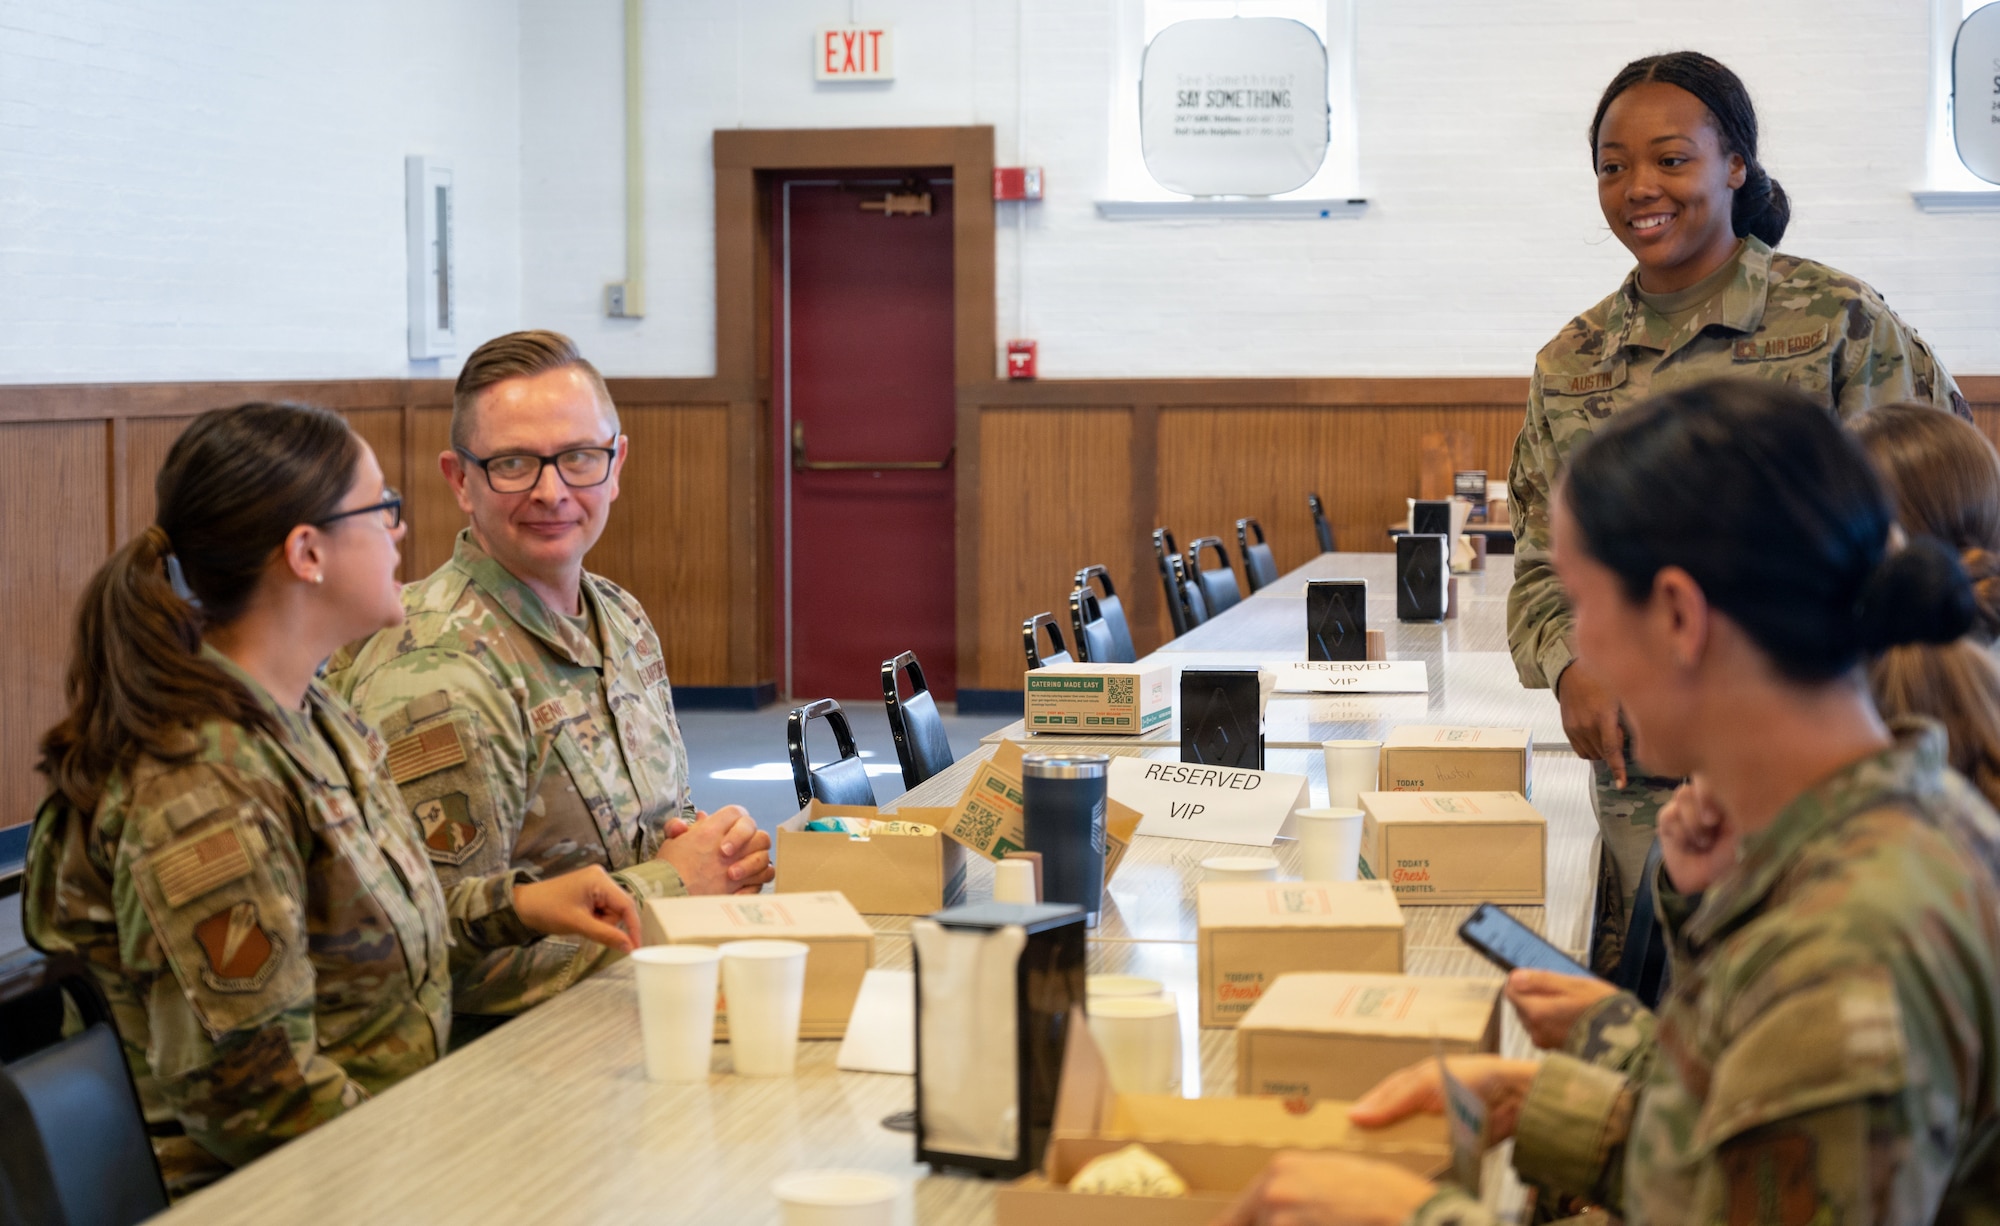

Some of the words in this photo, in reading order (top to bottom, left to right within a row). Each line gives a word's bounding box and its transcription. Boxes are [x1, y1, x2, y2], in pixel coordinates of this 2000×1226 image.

[825, 30, 884, 73] EXIT
[1177, 89, 1200, 108] SAY
[1764, 340, 1785, 356] AIR
[1787, 329, 1824, 354] FORCE
[1570, 371, 1612, 392] AUSTIN
[1293, 662, 1391, 672] RESERVED
[1031, 680, 1062, 688] CATERING
[1063, 681, 1082, 689] MADE
[1083, 681, 1099, 689] EASY
[1328, 677, 1358, 686] VIP
[1144, 763, 1262, 791] RESERVED
[1170, 801, 1206, 820] VIP
[1392, 868, 1431, 884] Fresh
[1217, 982, 1262, 1002] Fresh
